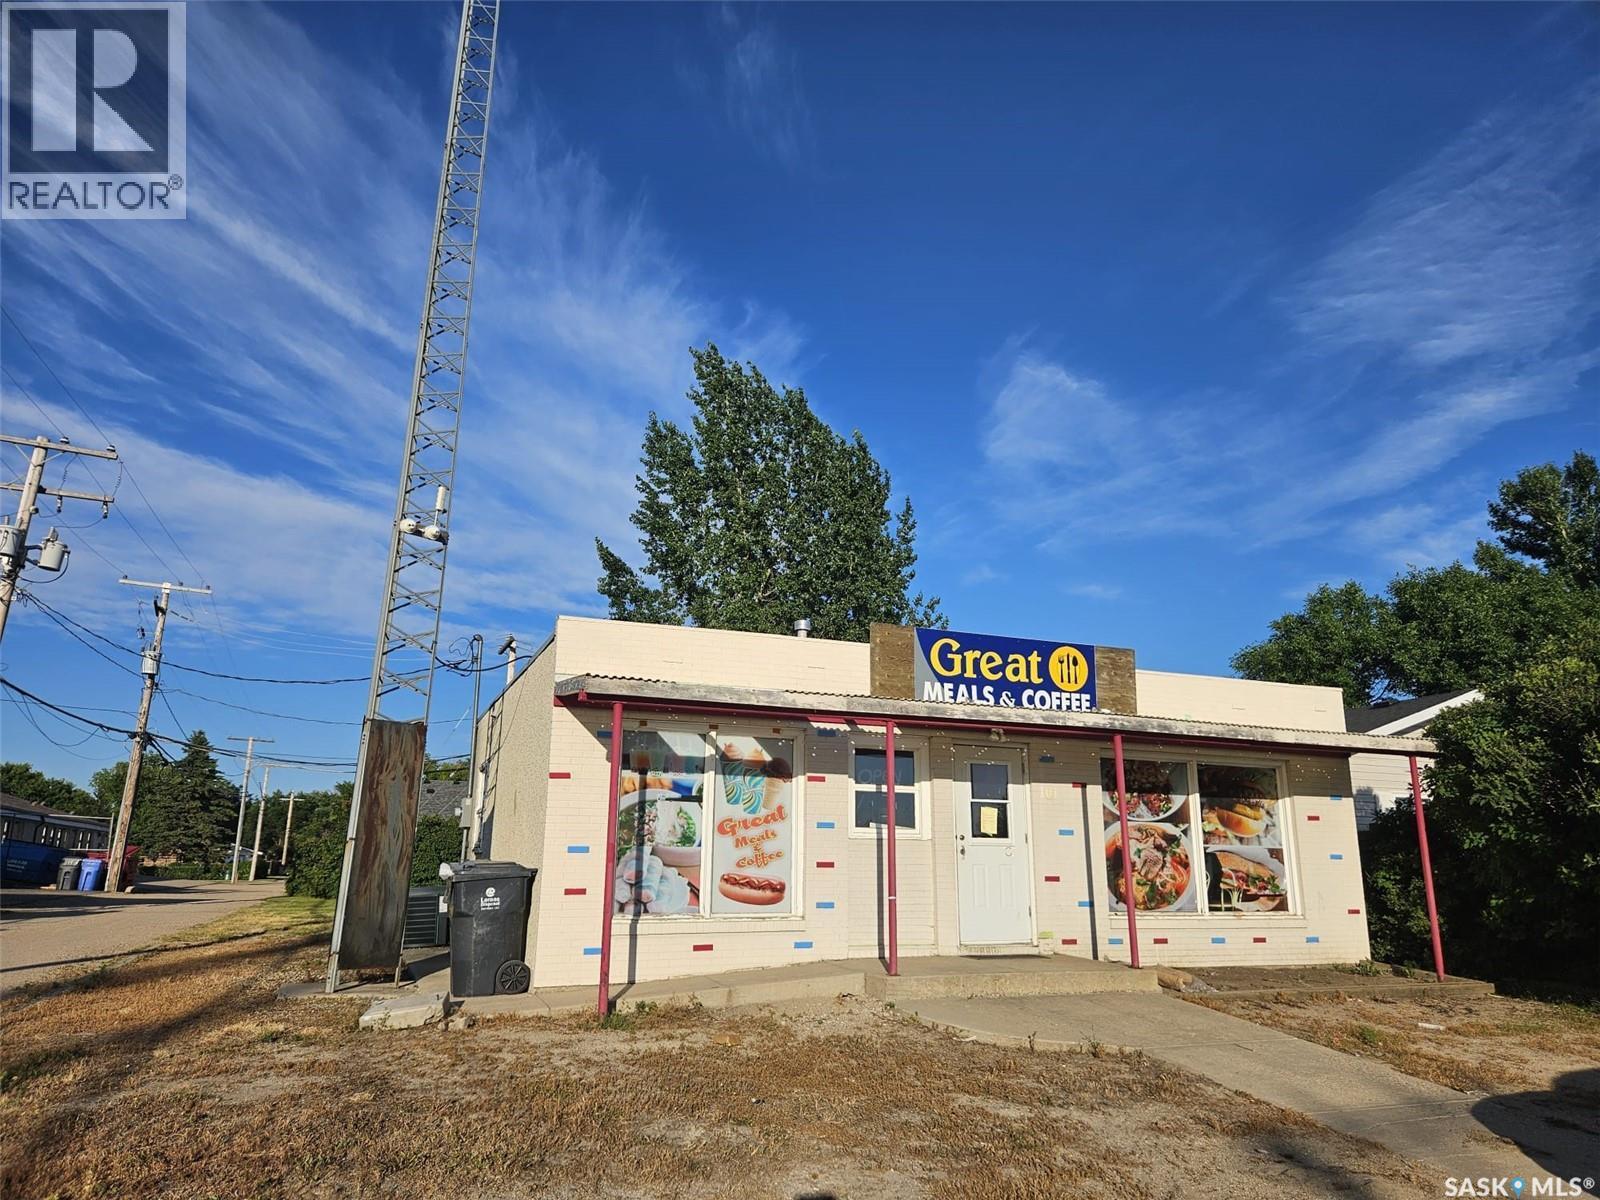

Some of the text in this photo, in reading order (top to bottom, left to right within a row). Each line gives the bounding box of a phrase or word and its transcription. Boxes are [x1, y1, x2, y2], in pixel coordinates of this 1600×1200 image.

[930, 637, 1044, 684] Great
[923, 681, 1091, 712] MEALS & COFFEE
[717, 804, 788, 836] Great
[735, 830, 777, 849] Meals
[736, 851, 784, 868] Coffee
